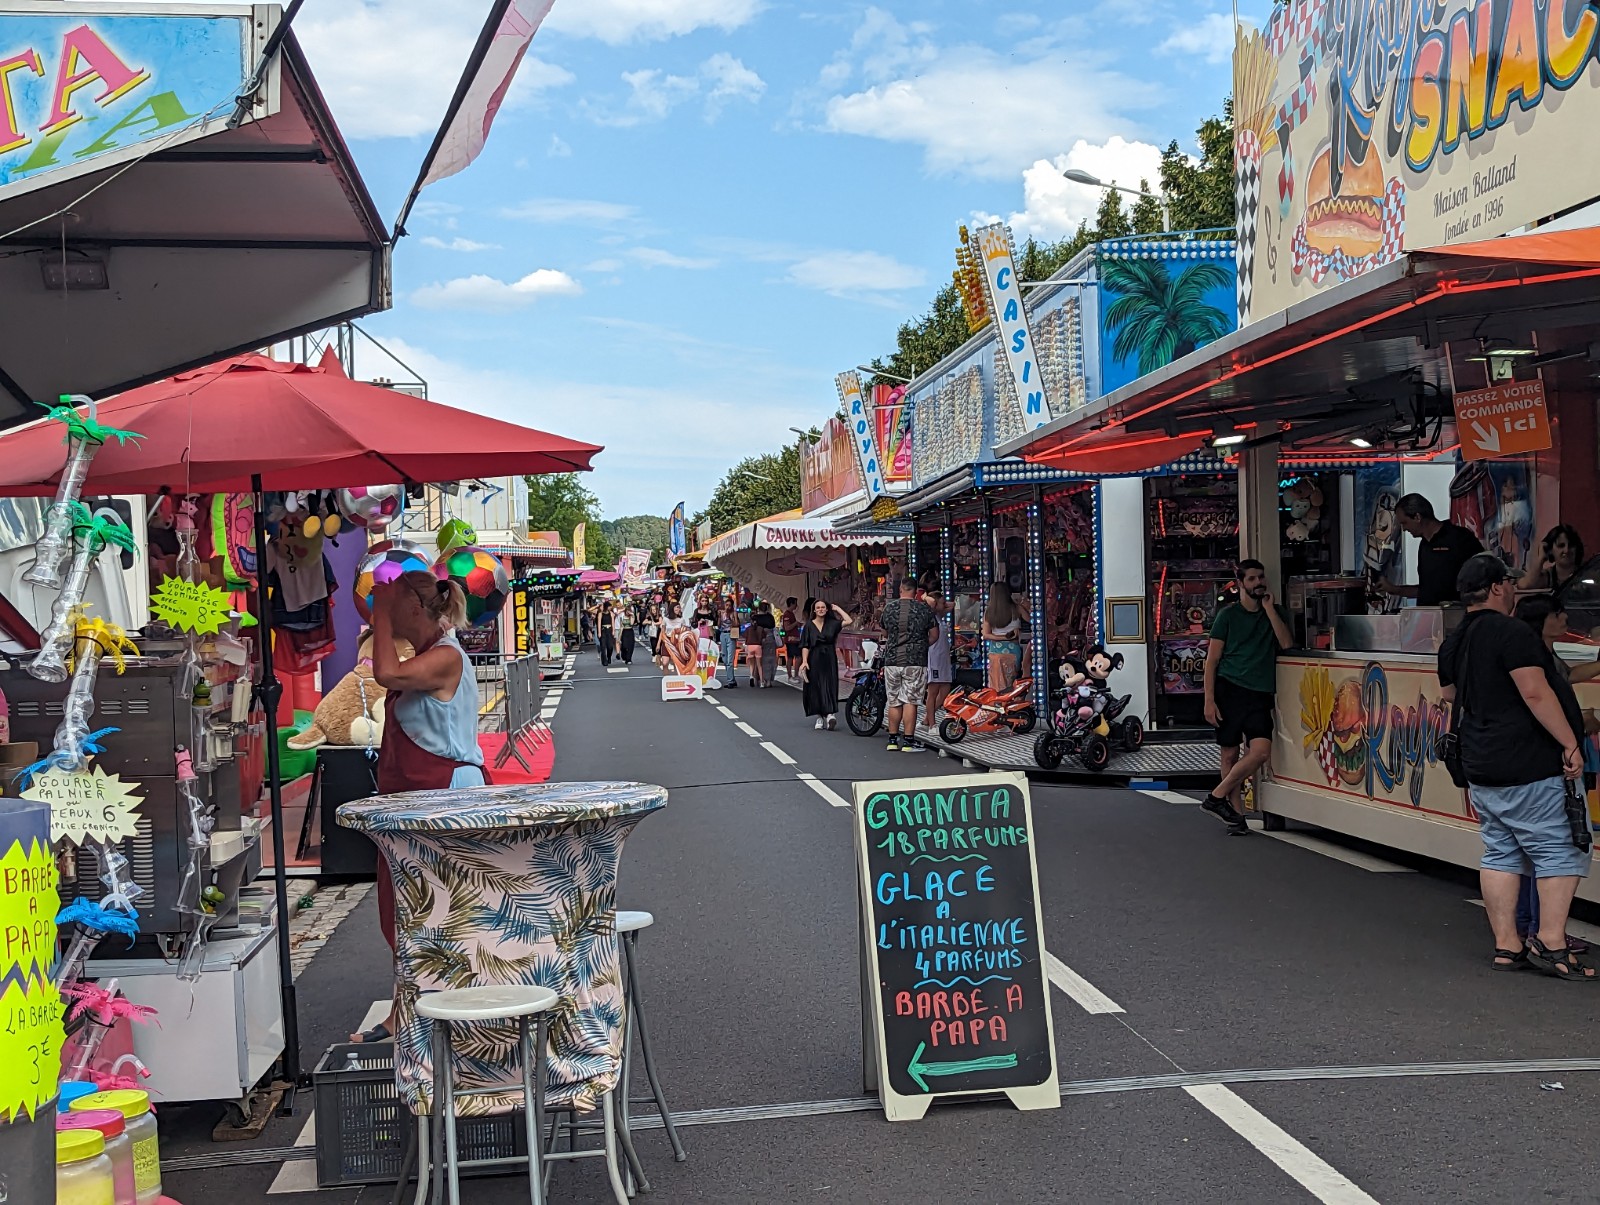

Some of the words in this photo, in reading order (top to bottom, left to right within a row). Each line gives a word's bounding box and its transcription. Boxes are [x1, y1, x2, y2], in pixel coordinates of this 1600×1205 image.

[0, 24, 149, 153] TA
[1406, 0, 1600, 172] SNAC
[1433, 185, 1468, 219] Maison
[1473, 155, 1517, 198] Balland
[1443, 210, 1469, 244] fondée
[1472, 211, 1482, 228] en
[1484, 197, 1505, 224] 1996
[996, 267, 1048, 429] CASIN
[1456, 391, 1498, 407] PASSEZ
[1503, 383, 1542, 399] VOTRE
[1459, 397, 1543, 420] COMMANDE
[1503, 413, 1537, 433] ici
[852, 400, 881, 492] ROYAL
[766, 527, 816, 543] GAUFRE
[168, 581, 209, 598] GOURDE
[528, 584, 563, 593] MONSTER
[696, 660, 715, 668] NITA
[39, 776, 105, 790] GOURDE
[39, 788, 105, 801] PALMIER
[51, 807, 93, 819] TEAUX
[866, 788, 1010, 830] GRANITA
[877, 830, 916, 858] 18
[917, 826, 1029, 851] PARFUMS
[4, 861, 53, 895] BARBE
[877, 865, 996, 906] GLACE
[29, 897, 38, 916] A
[936, 900, 950, 920] A
[6, 921, 52, 960] PAPA
[877, 917, 1028, 950] L'ITALIENNE
[914, 952, 931, 979] 4
[936, 948, 1023, 973] PARFUMS
[29, 1000, 60, 1029] BARBE
[895, 988, 988, 1019] BARBE
[1006, 985, 1024, 1011] A
[930, 1016, 1008, 1048] PAPA
